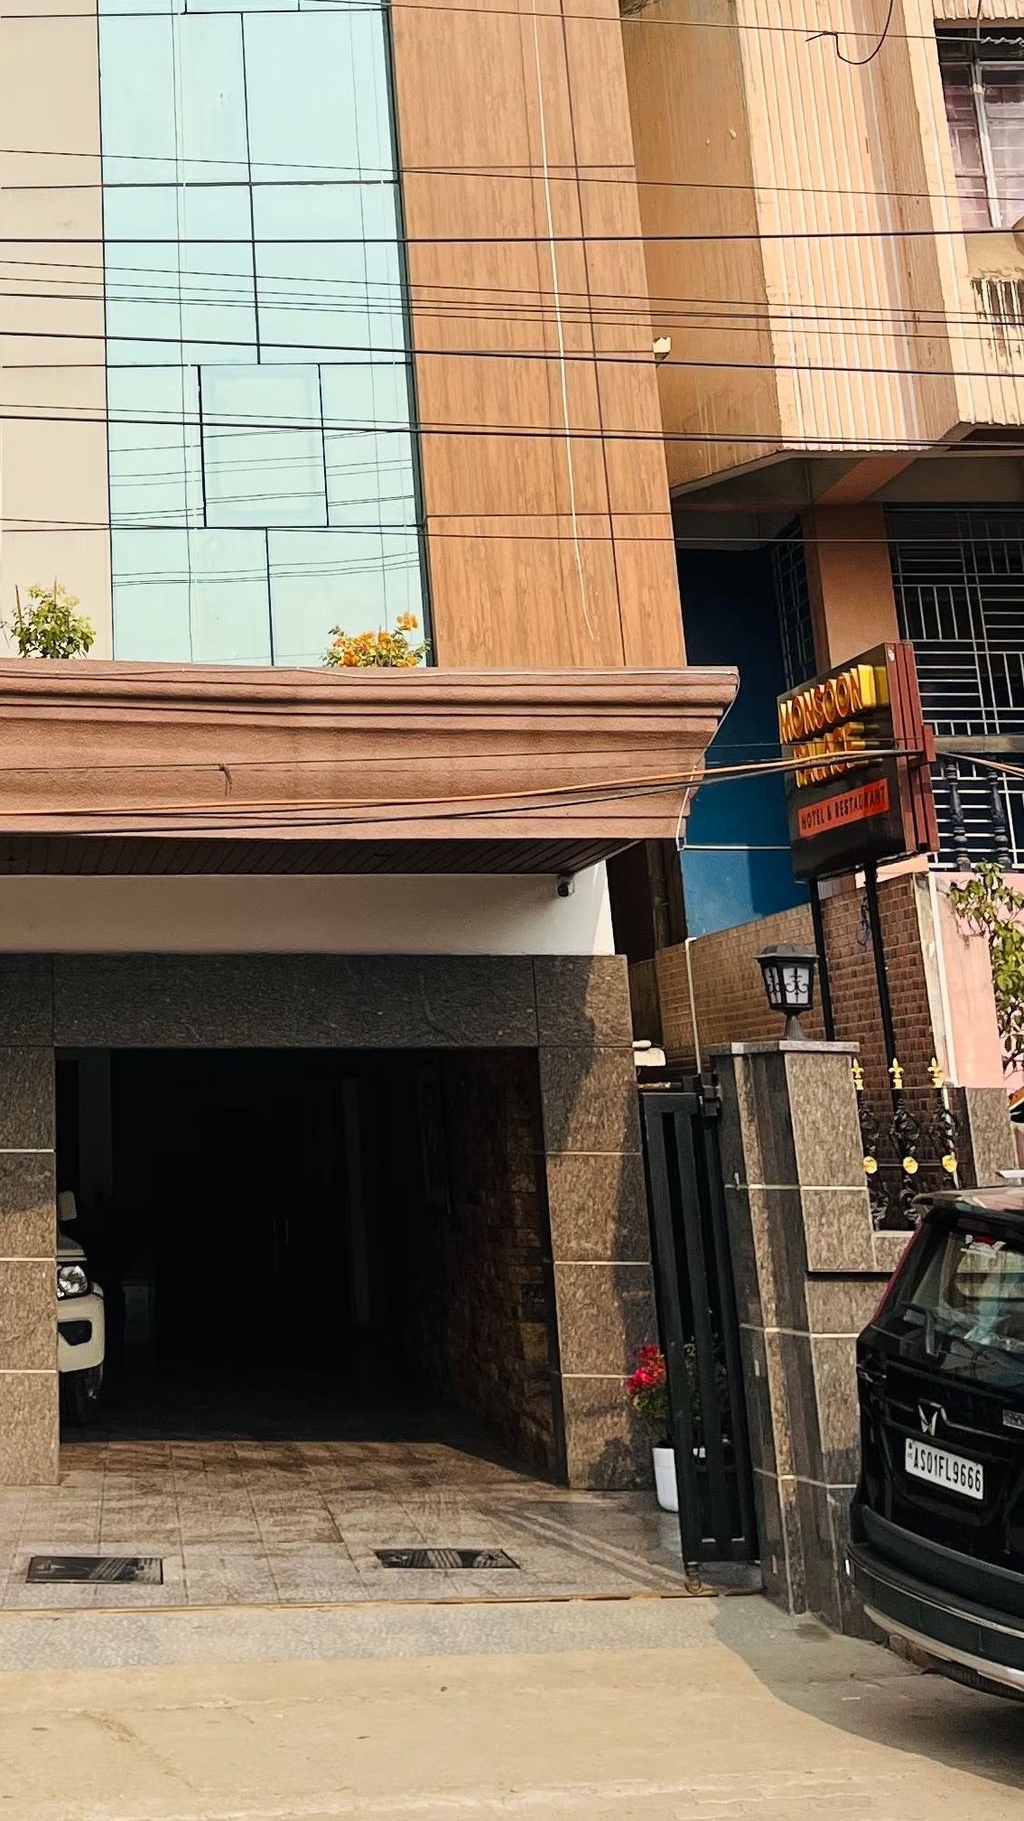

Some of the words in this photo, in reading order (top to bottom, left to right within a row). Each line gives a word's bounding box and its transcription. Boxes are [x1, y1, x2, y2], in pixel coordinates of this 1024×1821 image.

[779, 666, 868, 744] MONSOON
[801, 808, 825, 830] HOTEL
[834, 785, 885, 819] RESTAURANT
[913, 1447, 982, 1492] AS01FL9666
